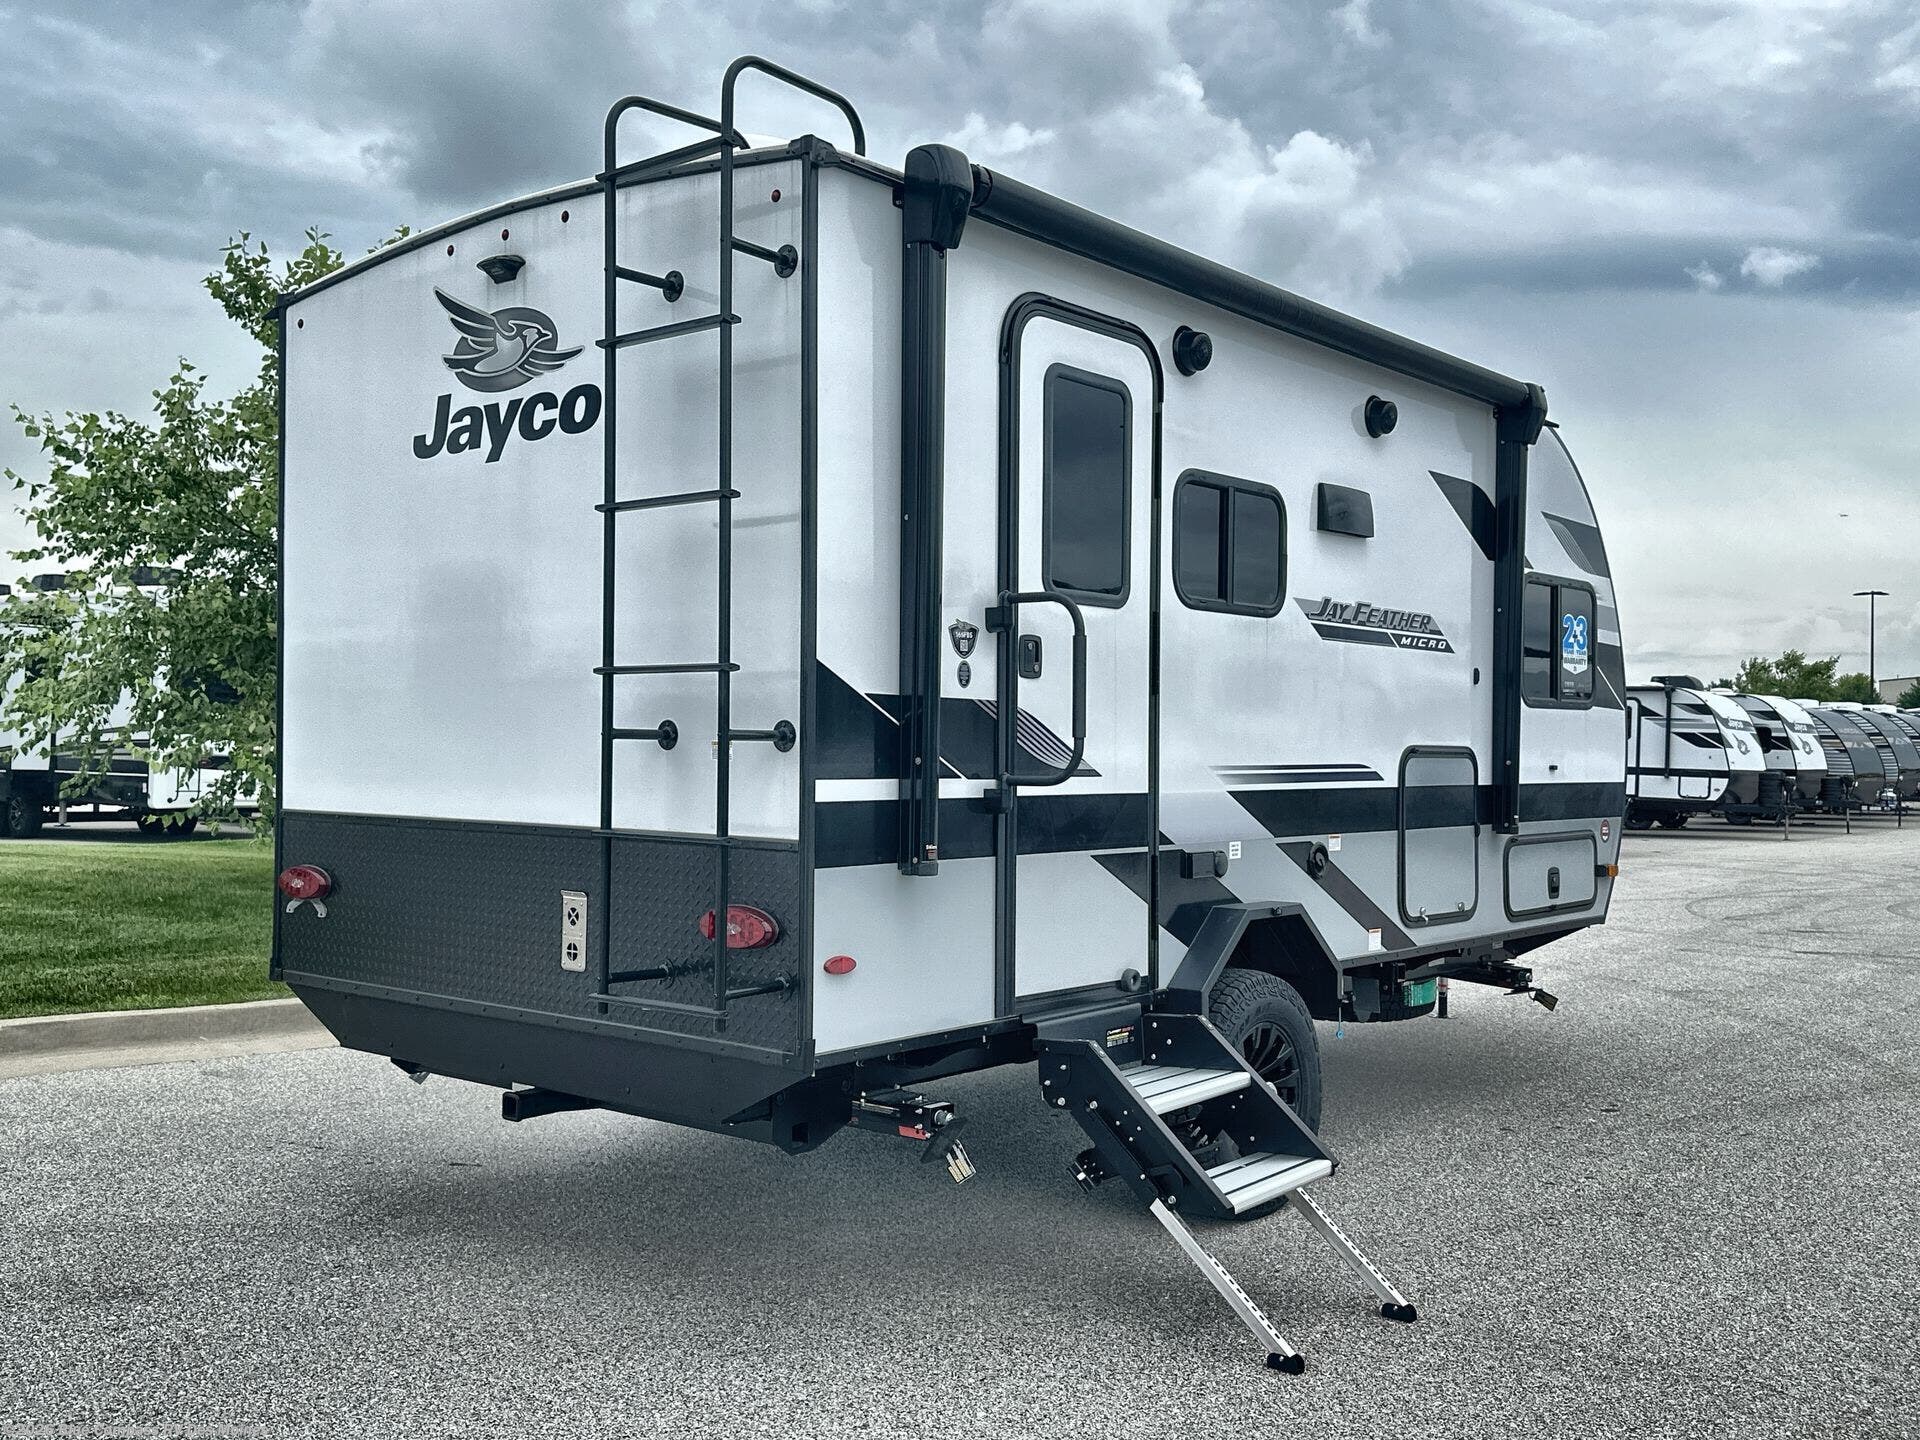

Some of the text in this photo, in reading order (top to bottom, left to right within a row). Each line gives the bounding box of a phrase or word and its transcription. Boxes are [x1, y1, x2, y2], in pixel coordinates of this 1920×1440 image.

[413, 384, 602, 463] Jayco
[1310, 597, 1434, 632] JAY FEATHER
[1400, 636, 1447, 650] MICRO
